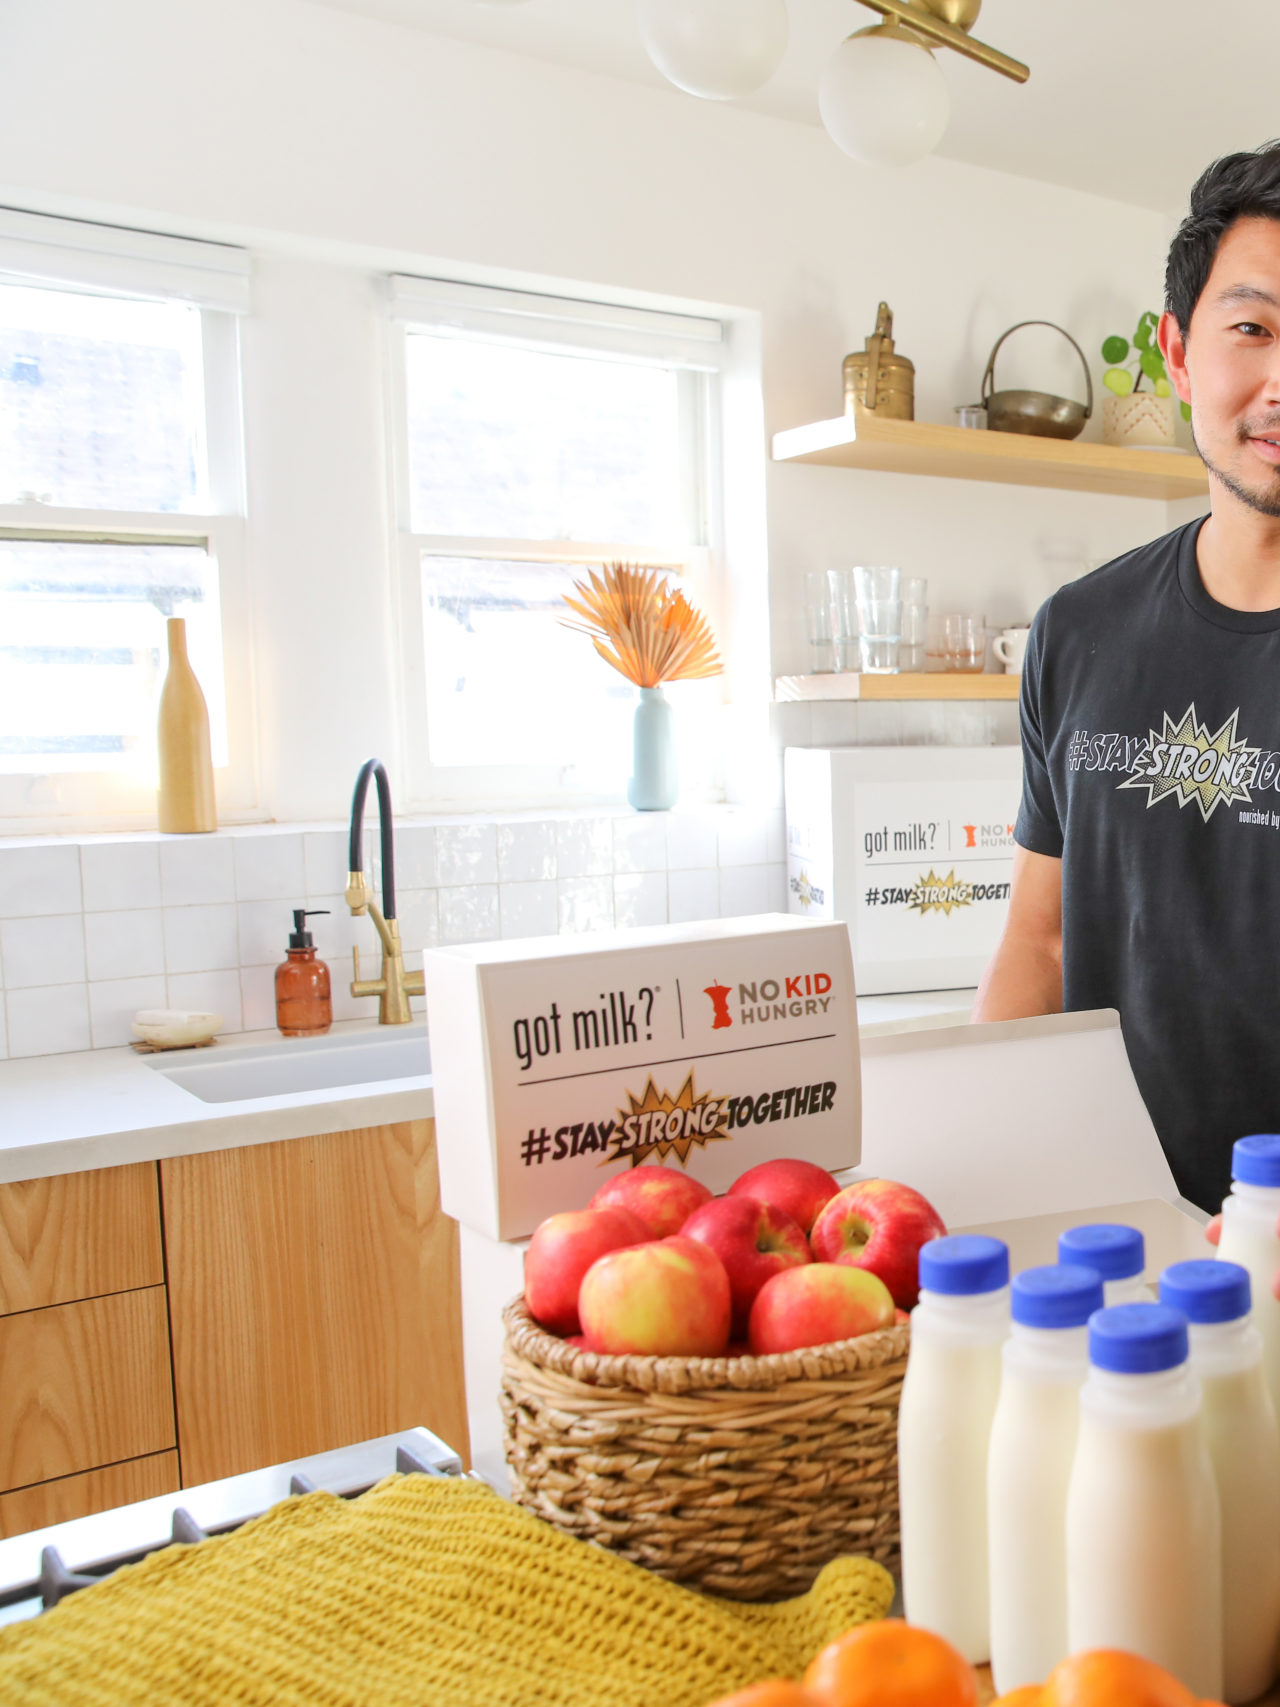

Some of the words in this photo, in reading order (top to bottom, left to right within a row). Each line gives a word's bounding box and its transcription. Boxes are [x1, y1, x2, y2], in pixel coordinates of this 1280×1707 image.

[1146, 743, 1249, 788] STRONG
[981, 824, 1004, 836] NO
[1238, 808, 1269, 826] nourished
[1271, 813, 1280, 830] by
[864, 826, 888, 858] got
[894, 822, 937, 854] milk?
[981, 837, 1016, 847] HUNG
[972, 882, 1010, 901] TOGET
[738, 979, 780, 1004] NO
[785, 972, 833, 999] KID
[741, 996, 832, 1025] HUNGRY
[513, 1003, 562, 1070] got
[574, 986, 656, 1050] milk?
[620, 1100, 721, 1150] STRONG
[727, 1081, 837, 1130] TOGETHER
